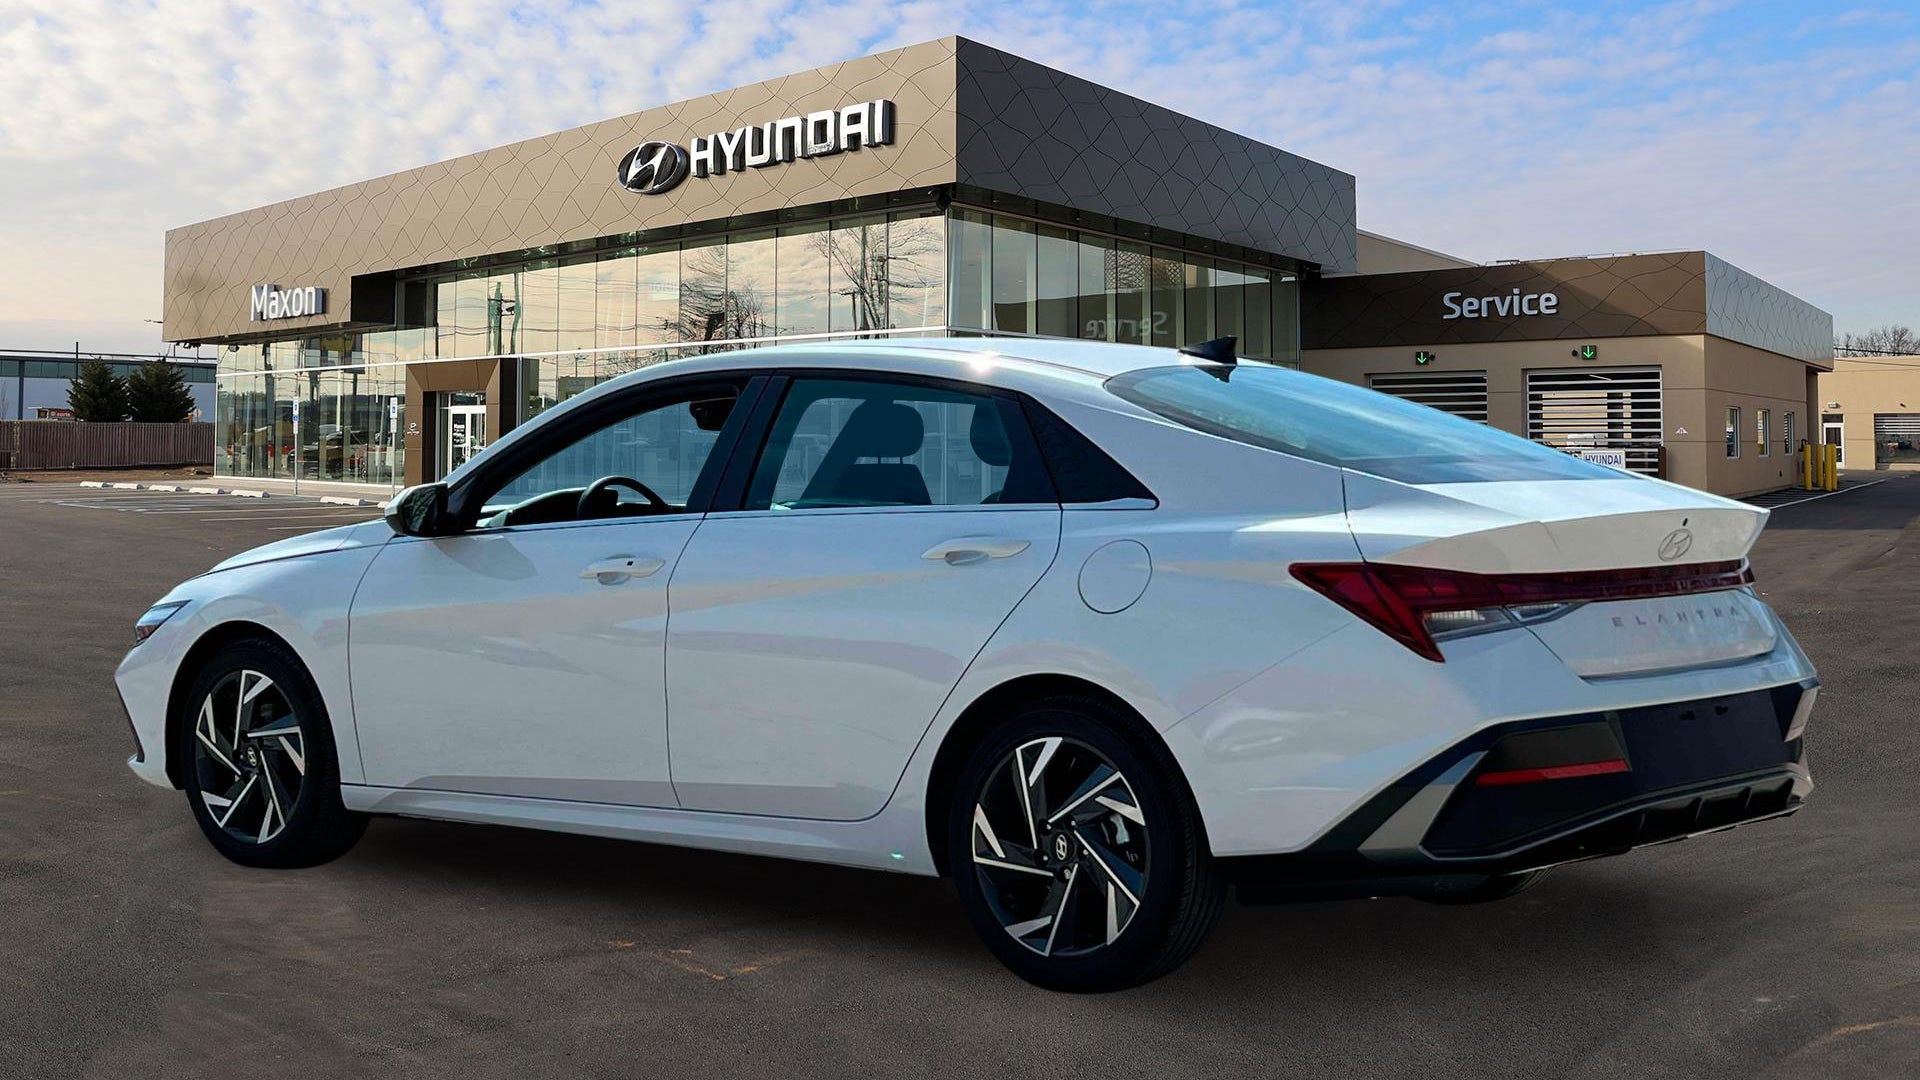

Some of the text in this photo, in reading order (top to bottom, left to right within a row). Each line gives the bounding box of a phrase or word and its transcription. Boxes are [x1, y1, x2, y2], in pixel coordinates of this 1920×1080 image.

[690, 99, 887, 177] HYUNDAI
[250, 284, 319, 321] Maxon
[1442, 288, 1559, 319] Service
[1611, 606, 1739, 628] ELANTRA
